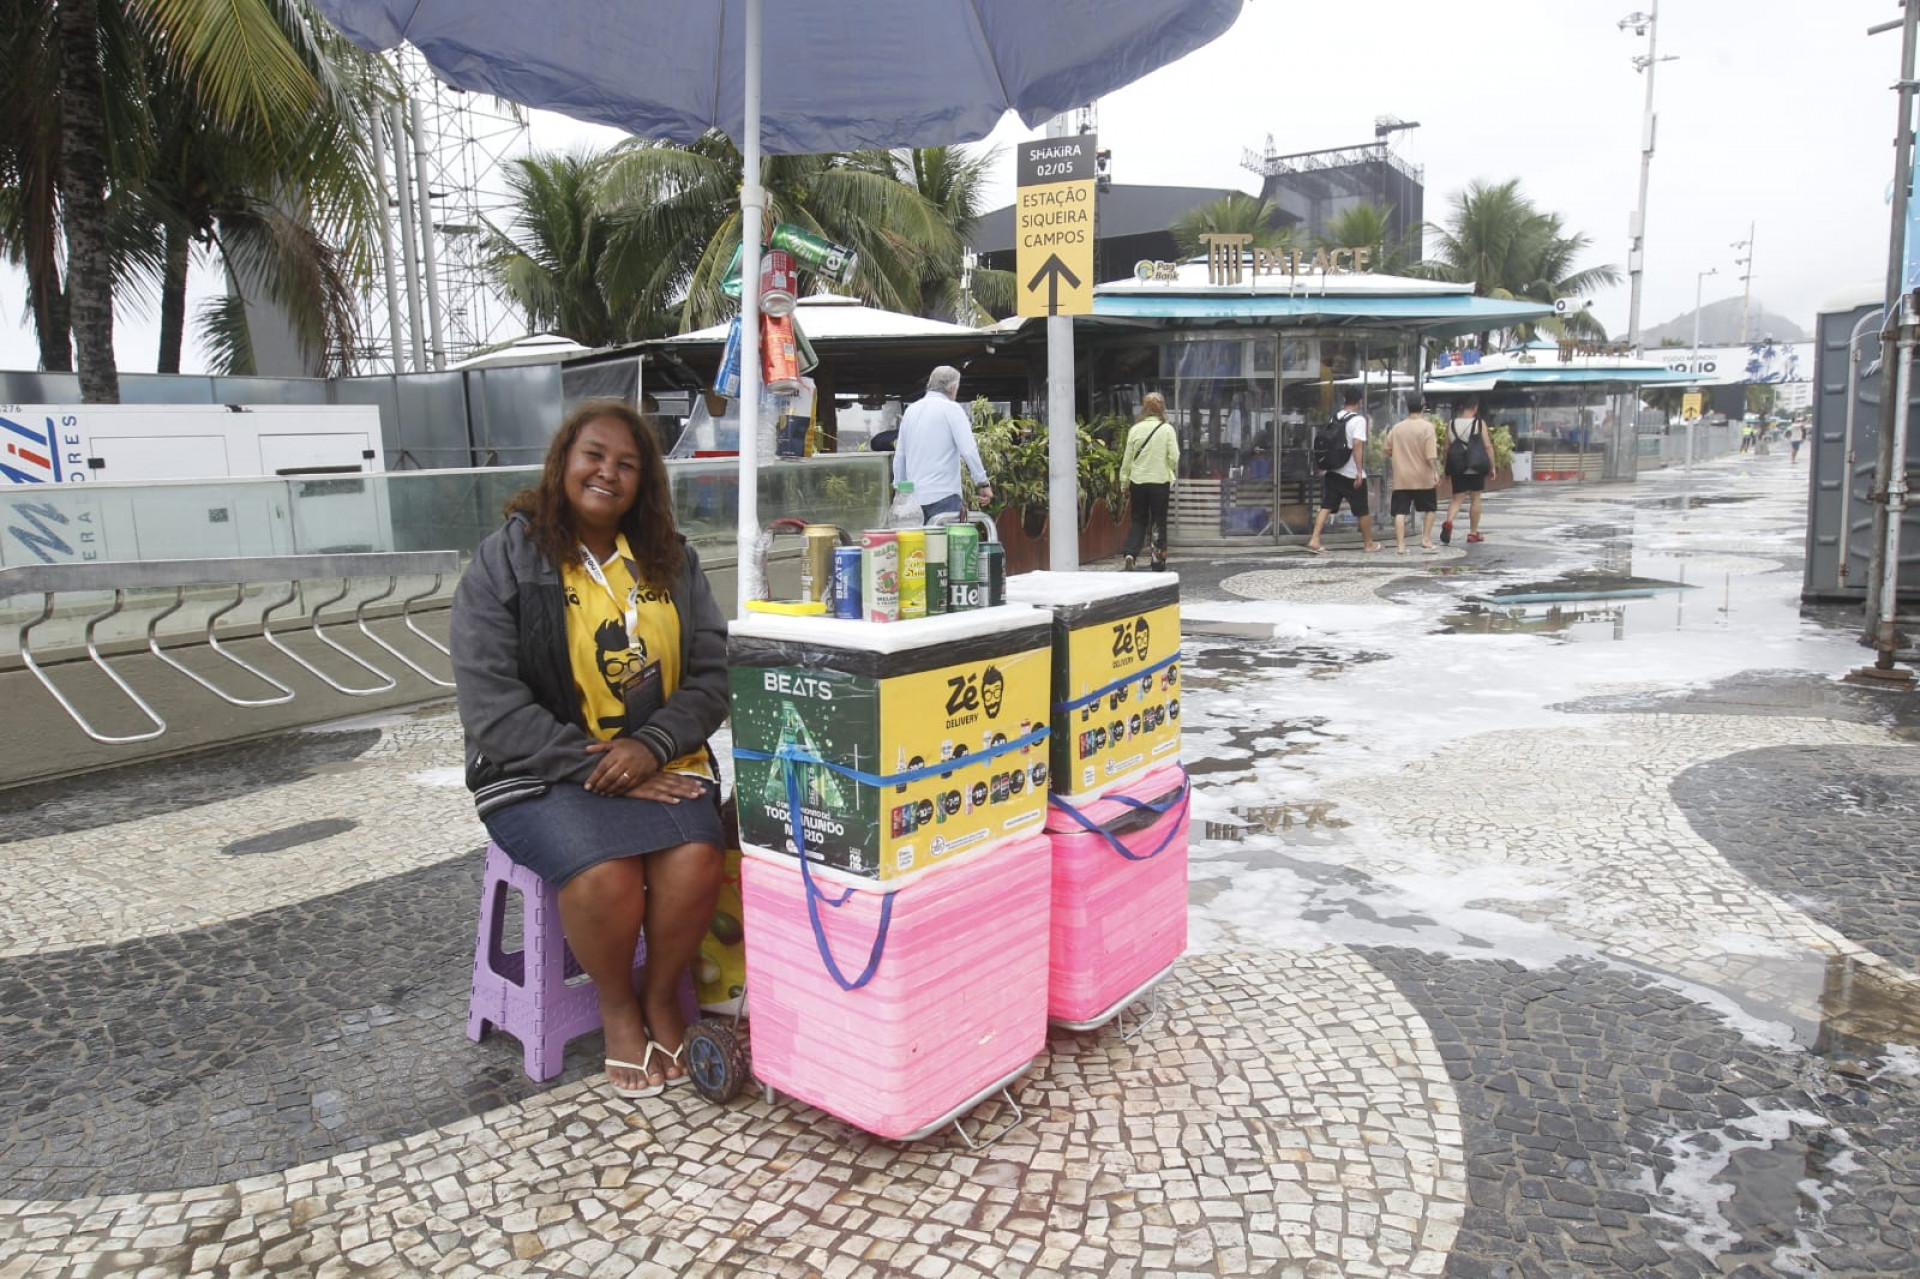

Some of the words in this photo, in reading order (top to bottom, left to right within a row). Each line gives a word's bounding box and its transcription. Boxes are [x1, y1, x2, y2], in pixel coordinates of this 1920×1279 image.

[1029, 144, 1081, 161] SHAKIRA
[1037, 162, 1073, 176] 02/05
[1023, 187, 1087, 208] ESTAÇÃO
[1022, 209, 1088, 228] SIQUEIRA
[1024, 230, 1085, 247] CAMPOS
[1252, 247, 1373, 276] PALACE
[835, 556, 843, 599] BEATS
[1112, 623, 1134, 658] Zé
[764, 672, 833, 700] BEATS
[945, 673, 980, 716] Zé
[946, 713, 979, 729] DELIVERY
[804, 829, 824, 844] RIO
